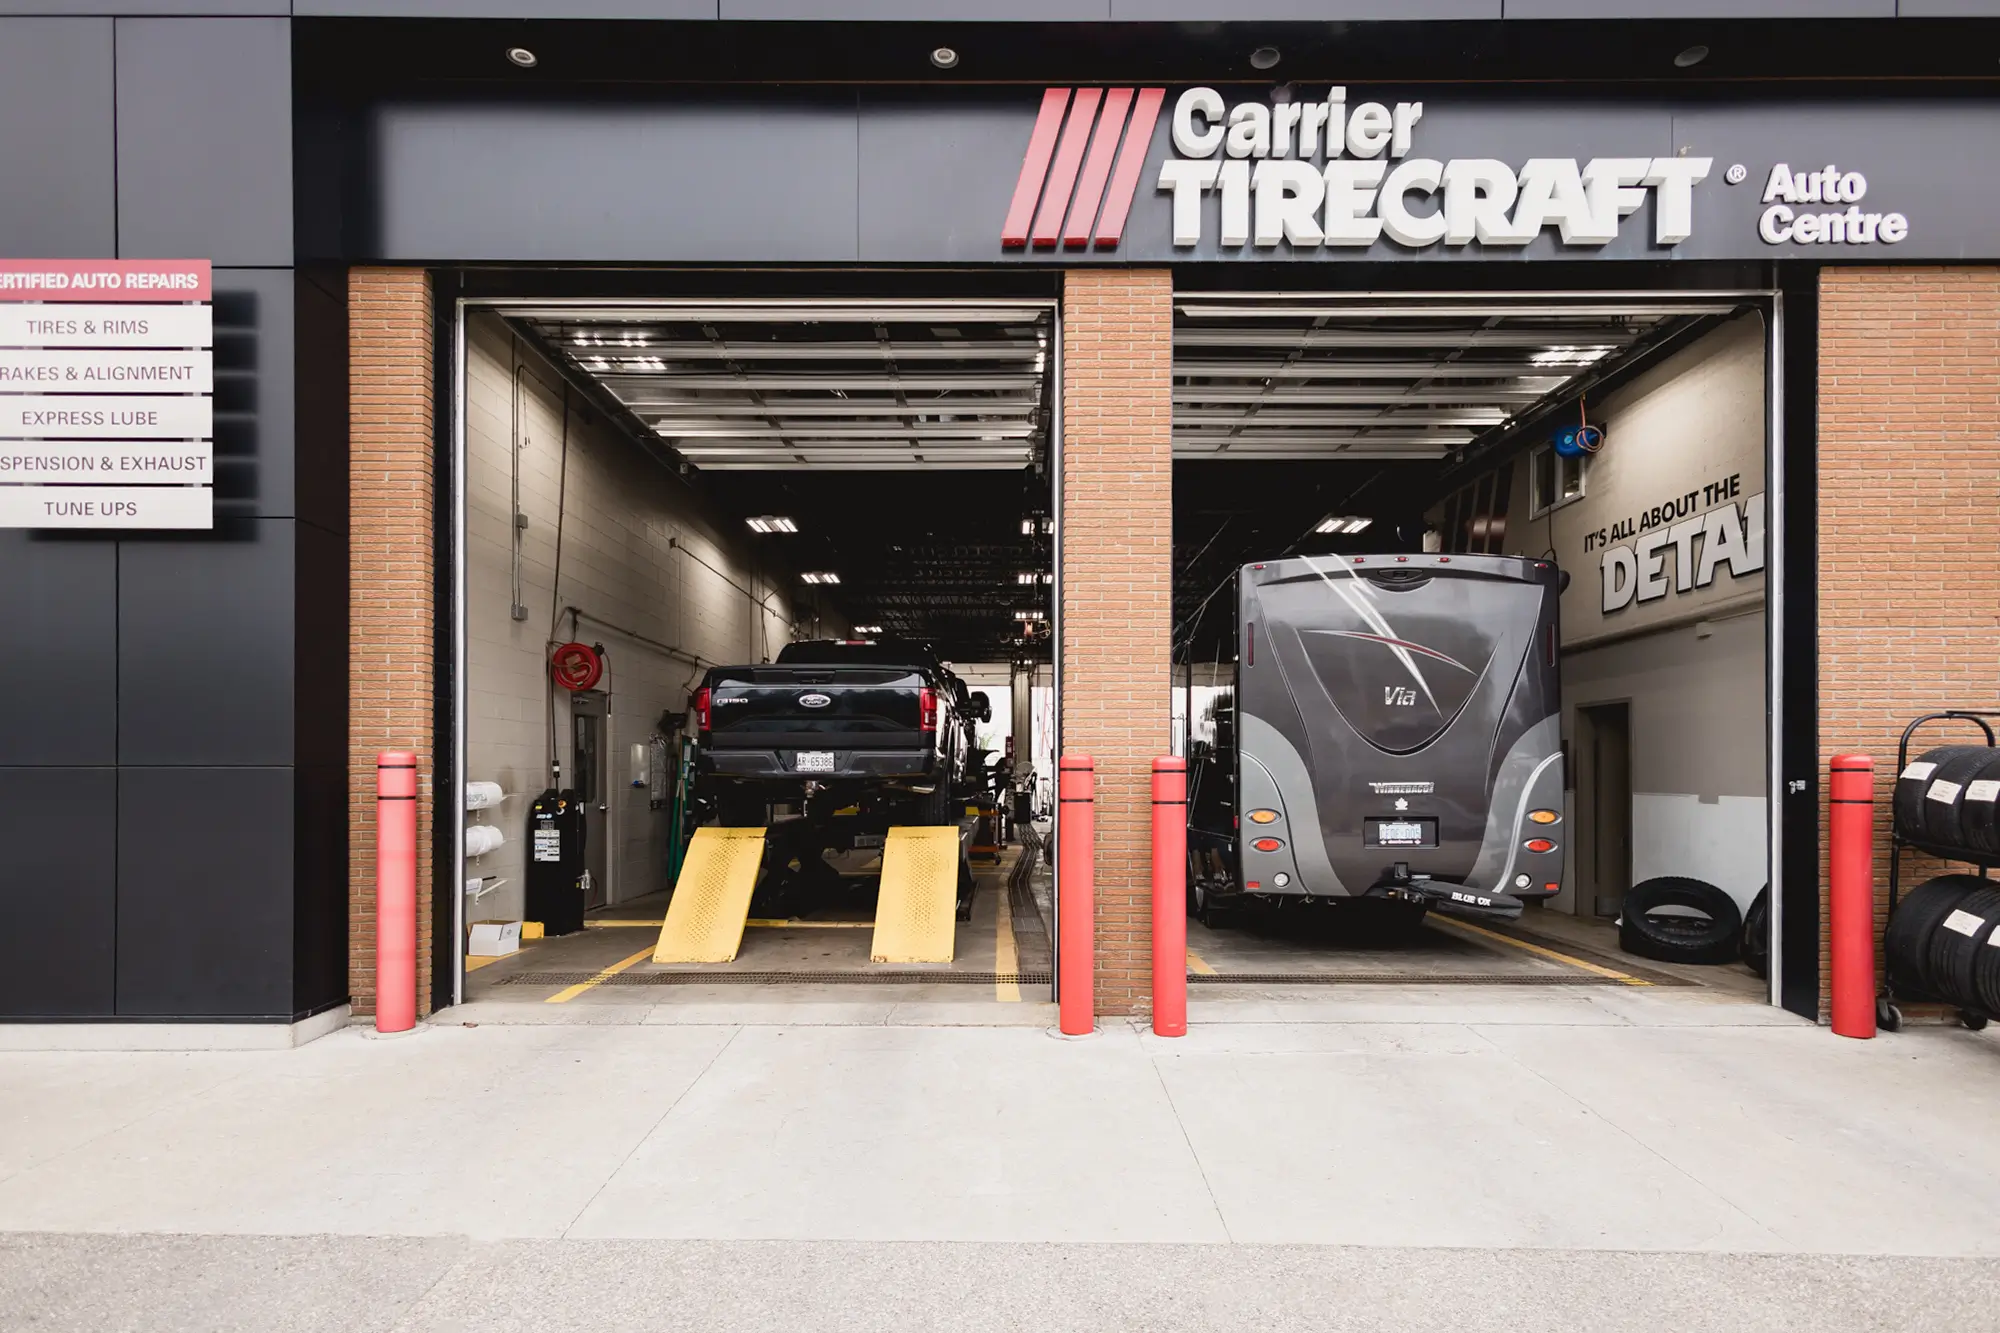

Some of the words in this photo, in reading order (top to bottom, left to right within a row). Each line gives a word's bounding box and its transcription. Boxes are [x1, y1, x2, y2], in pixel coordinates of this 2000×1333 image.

[1172, 86, 1423, 158] Carrier
[1763, 163, 1867, 202] Auto
[1157, 158, 1713, 247] TIRECRAFT
[1760, 204, 1908, 244] Centre
[71, 272, 121, 289] AUTO
[125, 272, 199, 289] REPAIRS
[26, 320, 77, 334] TIRES
[83, 320, 97, 335] &
[103, 320, 149, 334] RIMS
[65, 366, 79, 381] &
[84, 365, 194, 381] ALIGNMENT
[22, 411, 104, 426] EXPRESS
[111, 411, 158, 426] LUBE
[0, 456, 95, 471] SPENSION
[100, 456, 114, 471] &
[120, 456, 207, 471] EXHAUST
[44, 502, 94, 516] TUNE
[100, 502, 138, 516] UPS
[1584, 527, 1607, 553] IT'S
[1610, 517, 1636, 543] ALL
[1639, 490, 1699, 532] ABOUT
[1703, 473, 1740, 507] THE
[1384, 686, 1417, 706] Via
[1451, 891, 1476, 904] BLUE
[1477, 896, 1491, 906] OX
